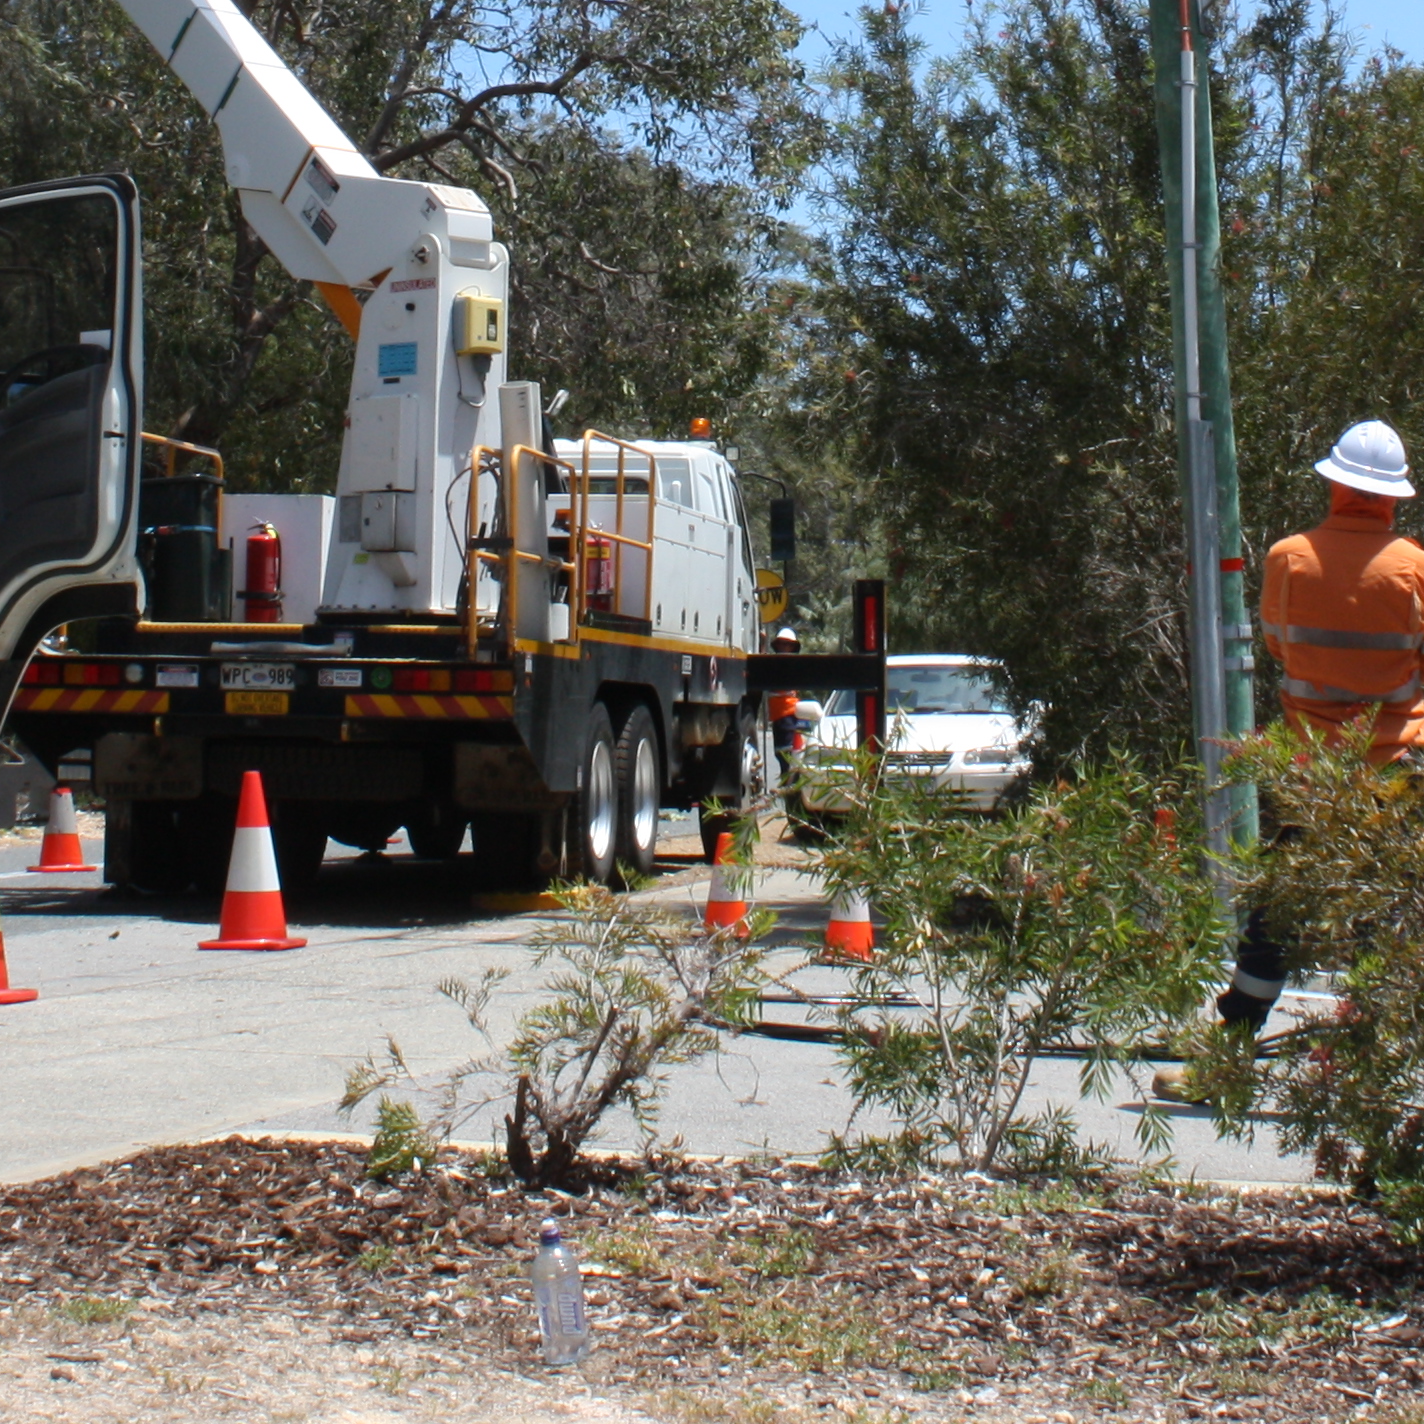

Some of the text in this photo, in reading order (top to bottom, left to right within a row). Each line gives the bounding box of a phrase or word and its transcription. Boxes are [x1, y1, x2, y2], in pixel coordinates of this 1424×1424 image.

[759, 589, 782, 605] OW
[222, 668, 294, 685] WPC 989
[557, 1292, 582, 1335] pump
